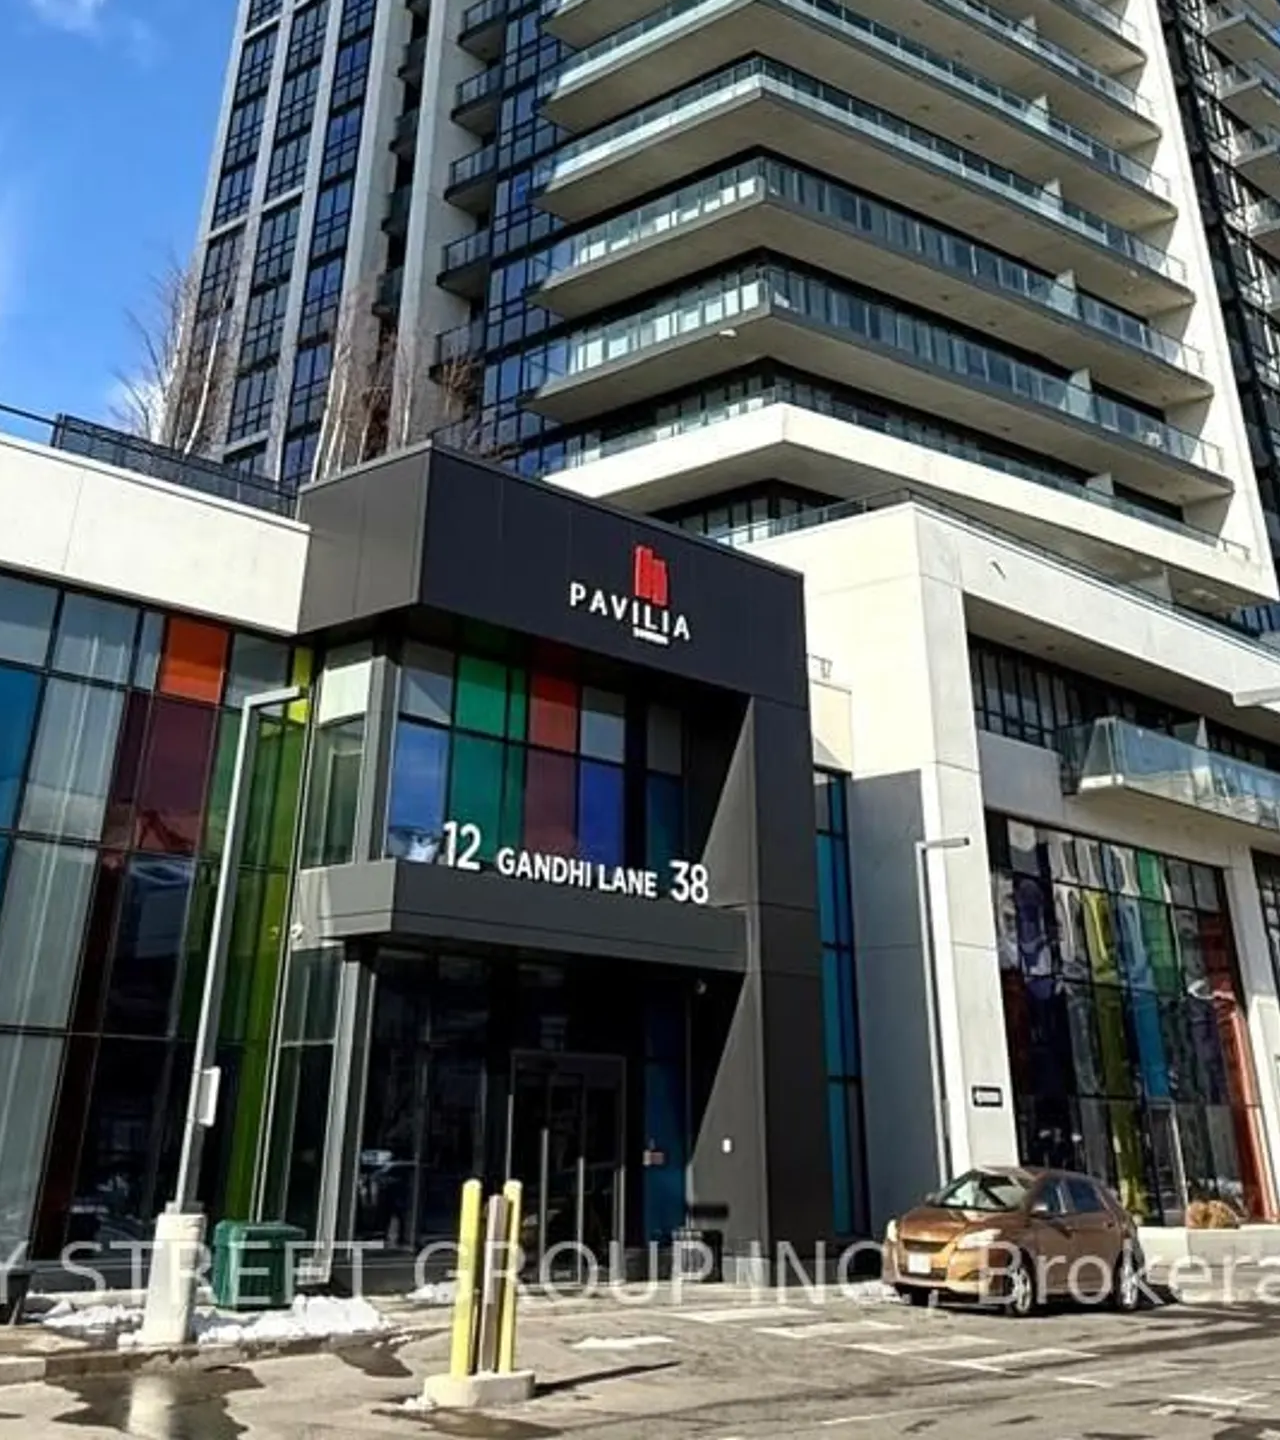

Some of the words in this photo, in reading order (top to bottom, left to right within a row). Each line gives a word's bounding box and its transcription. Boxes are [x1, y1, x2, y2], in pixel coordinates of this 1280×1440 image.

[569, 581, 690, 641] PAVILIA
[442, 820, 481, 871] 12
[497, 847, 592, 888] GANDHI
[598, 863, 657, 898] LANE
[670, 861, 709, 904] 38
